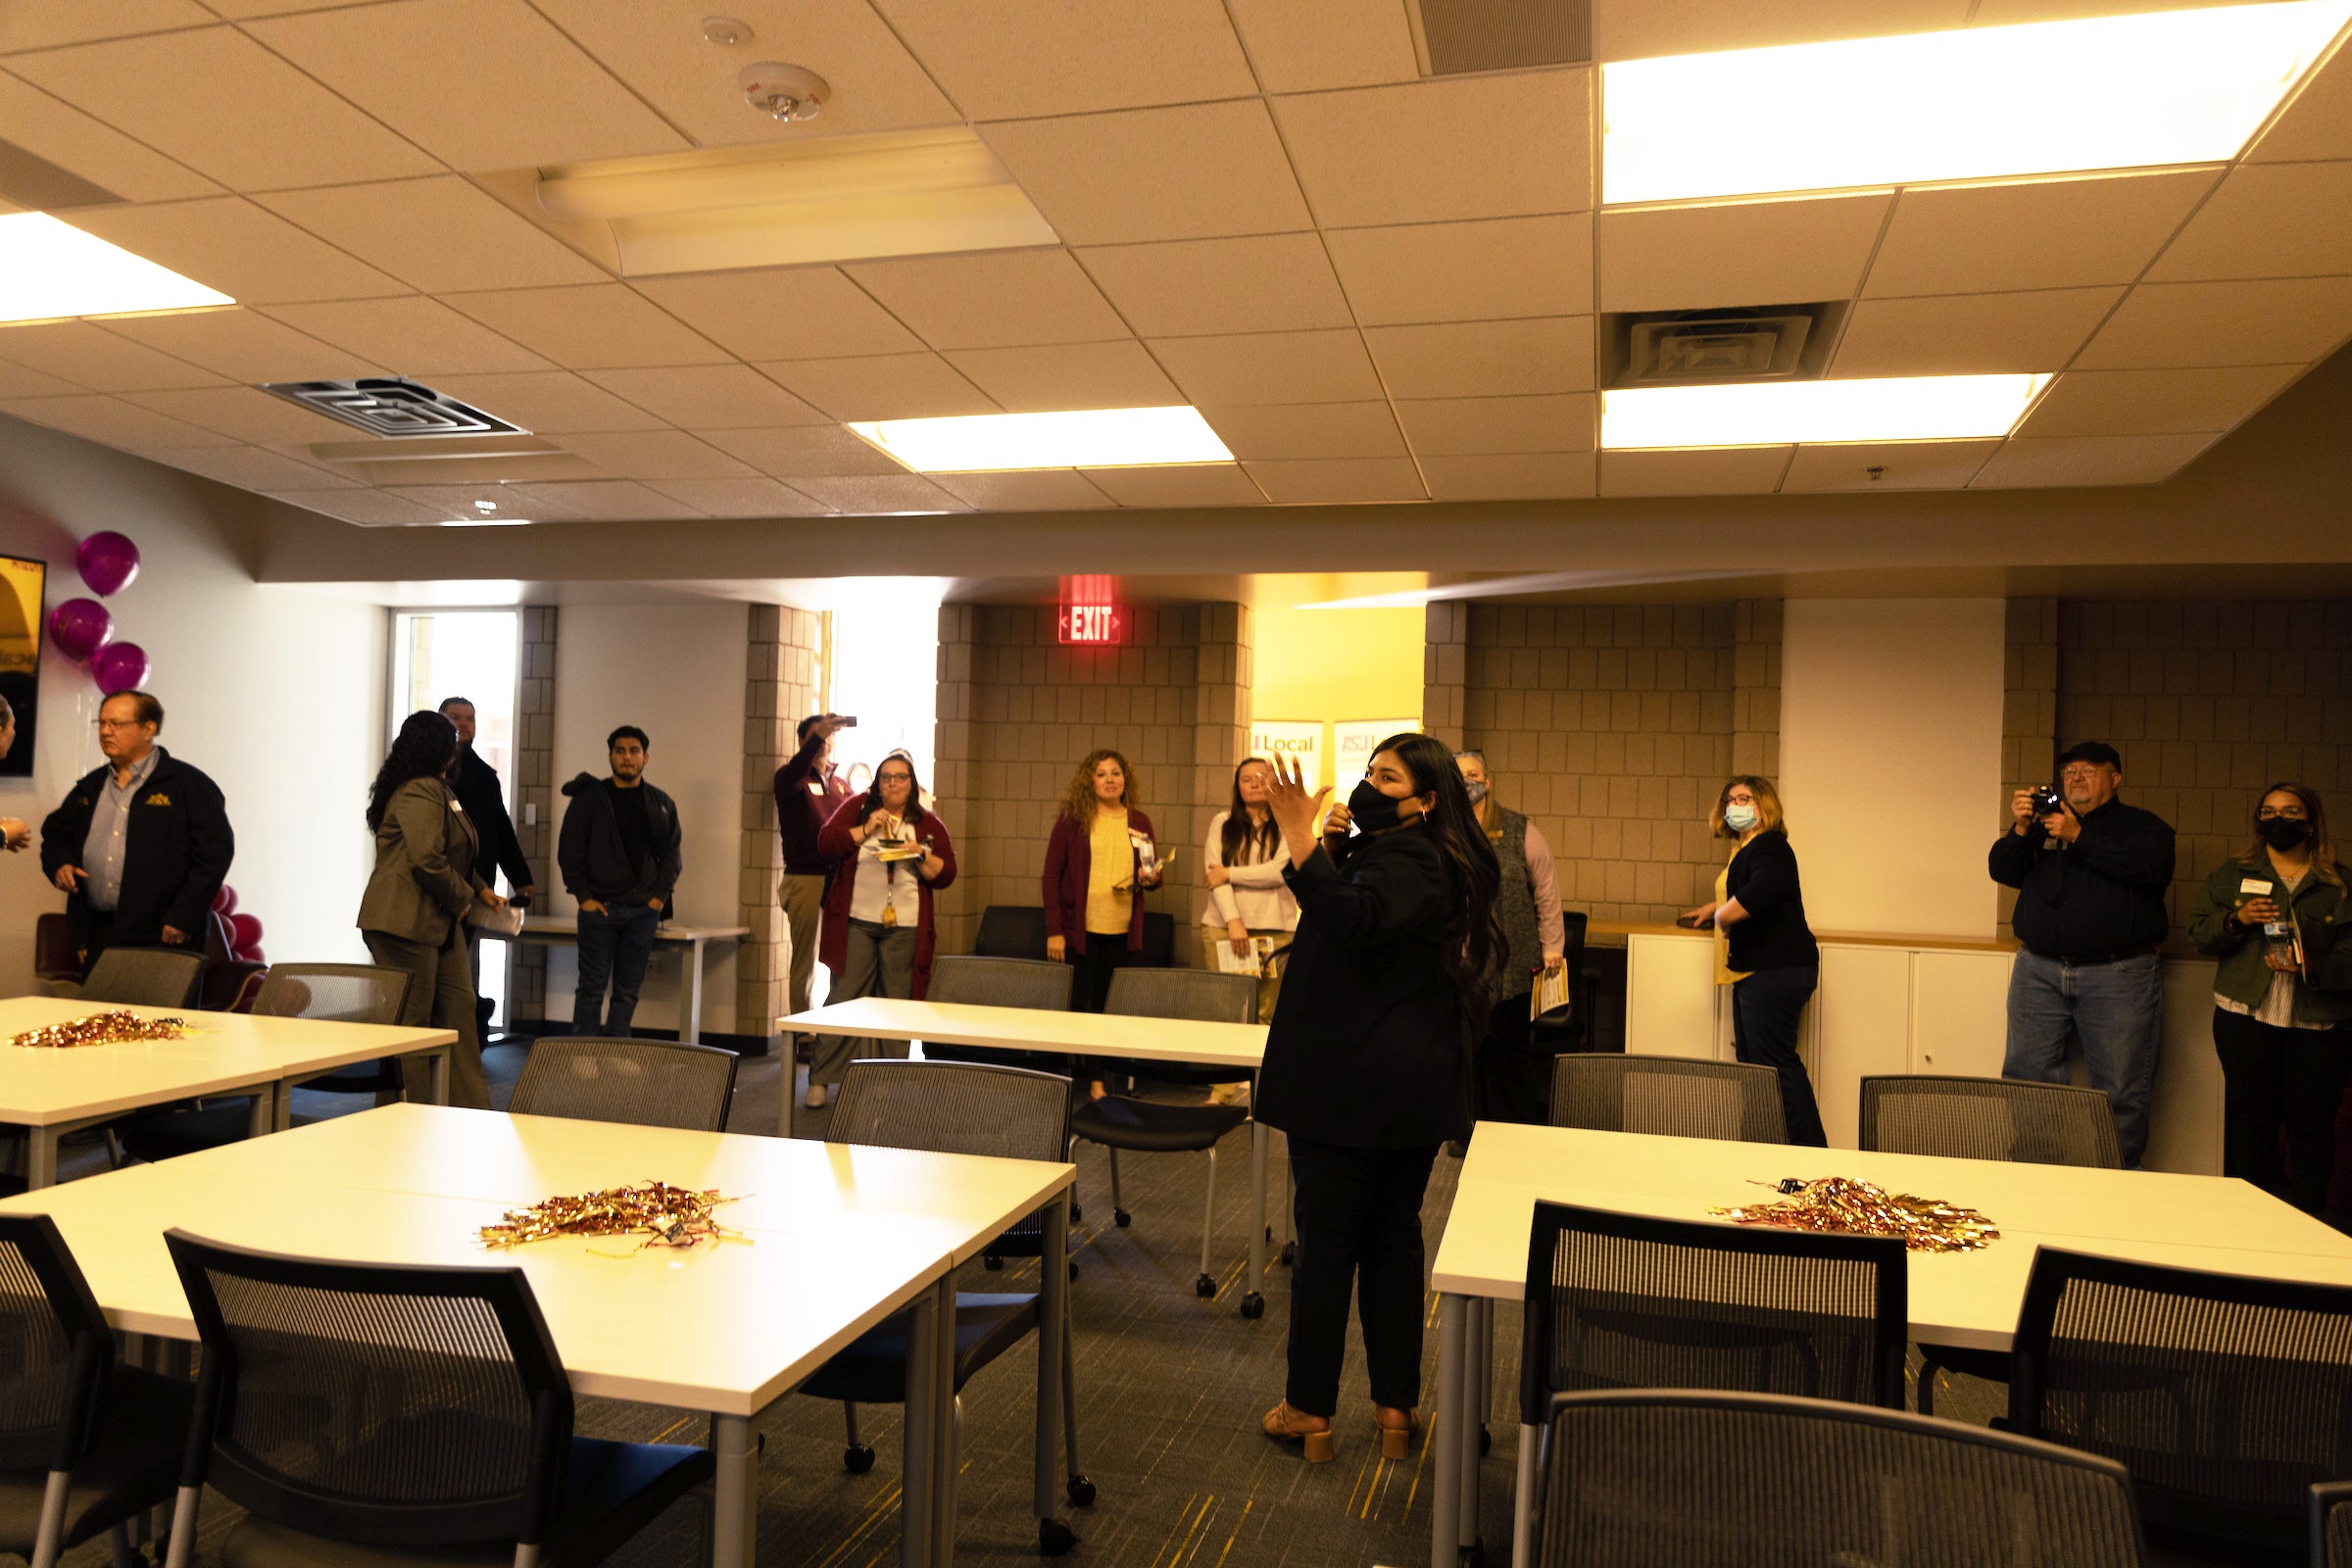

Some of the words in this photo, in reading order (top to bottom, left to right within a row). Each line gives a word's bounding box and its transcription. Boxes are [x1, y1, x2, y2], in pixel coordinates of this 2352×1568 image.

[1071, 606, 1111, 640] EXIT
[1264, 735, 1312, 752] Local
[1342, 735, 1368, 752] ASU
